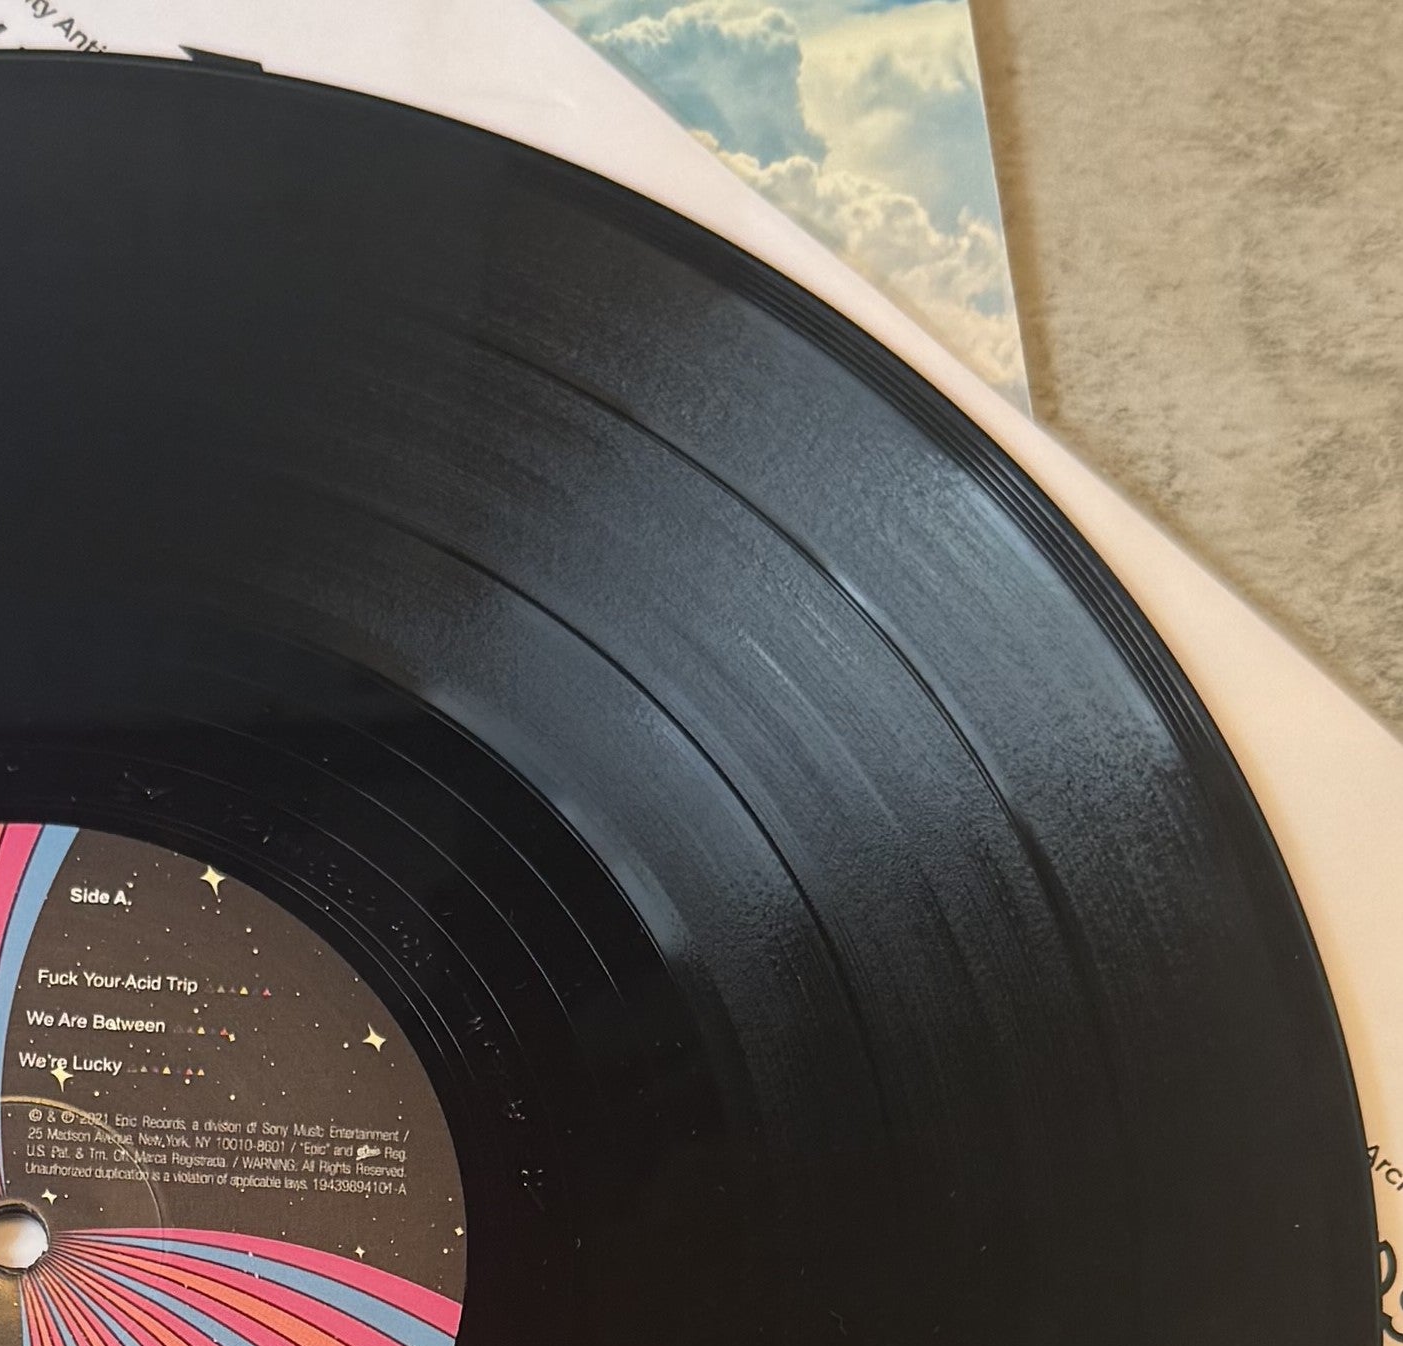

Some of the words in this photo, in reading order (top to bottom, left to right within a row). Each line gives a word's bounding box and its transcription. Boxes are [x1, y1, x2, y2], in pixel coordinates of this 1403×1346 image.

[71, 887, 109, 904] Side
[114, 890, 132, 906] A.
[38, 969, 78, 986] Fuck
[83, 971, 121, 988] Your
[124, 974, 161, 990] Acid
[166, 976, 198, 995] Trip
[26, 1010, 54, 1026] We
[58, 1012, 87, 1028] Are
[93, 1014, 166, 1033] Between
[18, 1051, 67, 1069] We're
[73, 1055, 122, 1076] Lucky
[47, 1109, 56, 1122] &
[115, 1113, 137, 1127] Epic
[192, 1120, 199, 1131] a
[204, 1119, 241, 1134] division
[246, 1121, 257, 1134] of
[262, 1122, 289, 1138] Sony
[293, 1123, 324, 1138] Music
[329, 1125, 399, 1142] Entertainment
[28, 1126, 43, 1140] 25
[47, 1127, 91, 1142] Madison
[138, 1132, 163, 1147] New
[196, 1136, 212, 1149] NY
[216, 1137, 285, 1153] 10010-8601
[333, 1145, 354, 1157] and
[75, 1147, 84, 1160] &
[134, 1150, 167, 1164] Marca
[301, 1159, 315, 1173] All
[319, 1160, 351, 1176] Rights
[356, 1162, 407, 1178] Reserved.
[25, 1161, 92, 1178] Unauthorized
[95, 1166, 149, 1182] duplication
[151, 1171, 161, 1182] is
[163, 1171, 170, 1182] a
[173, 1170, 214, 1185] violation
[217, 1173, 228, 1185] of
[229, 1174, 281, 1189] applicable
[313, 1177, 407, 1196] 19439894101-A
